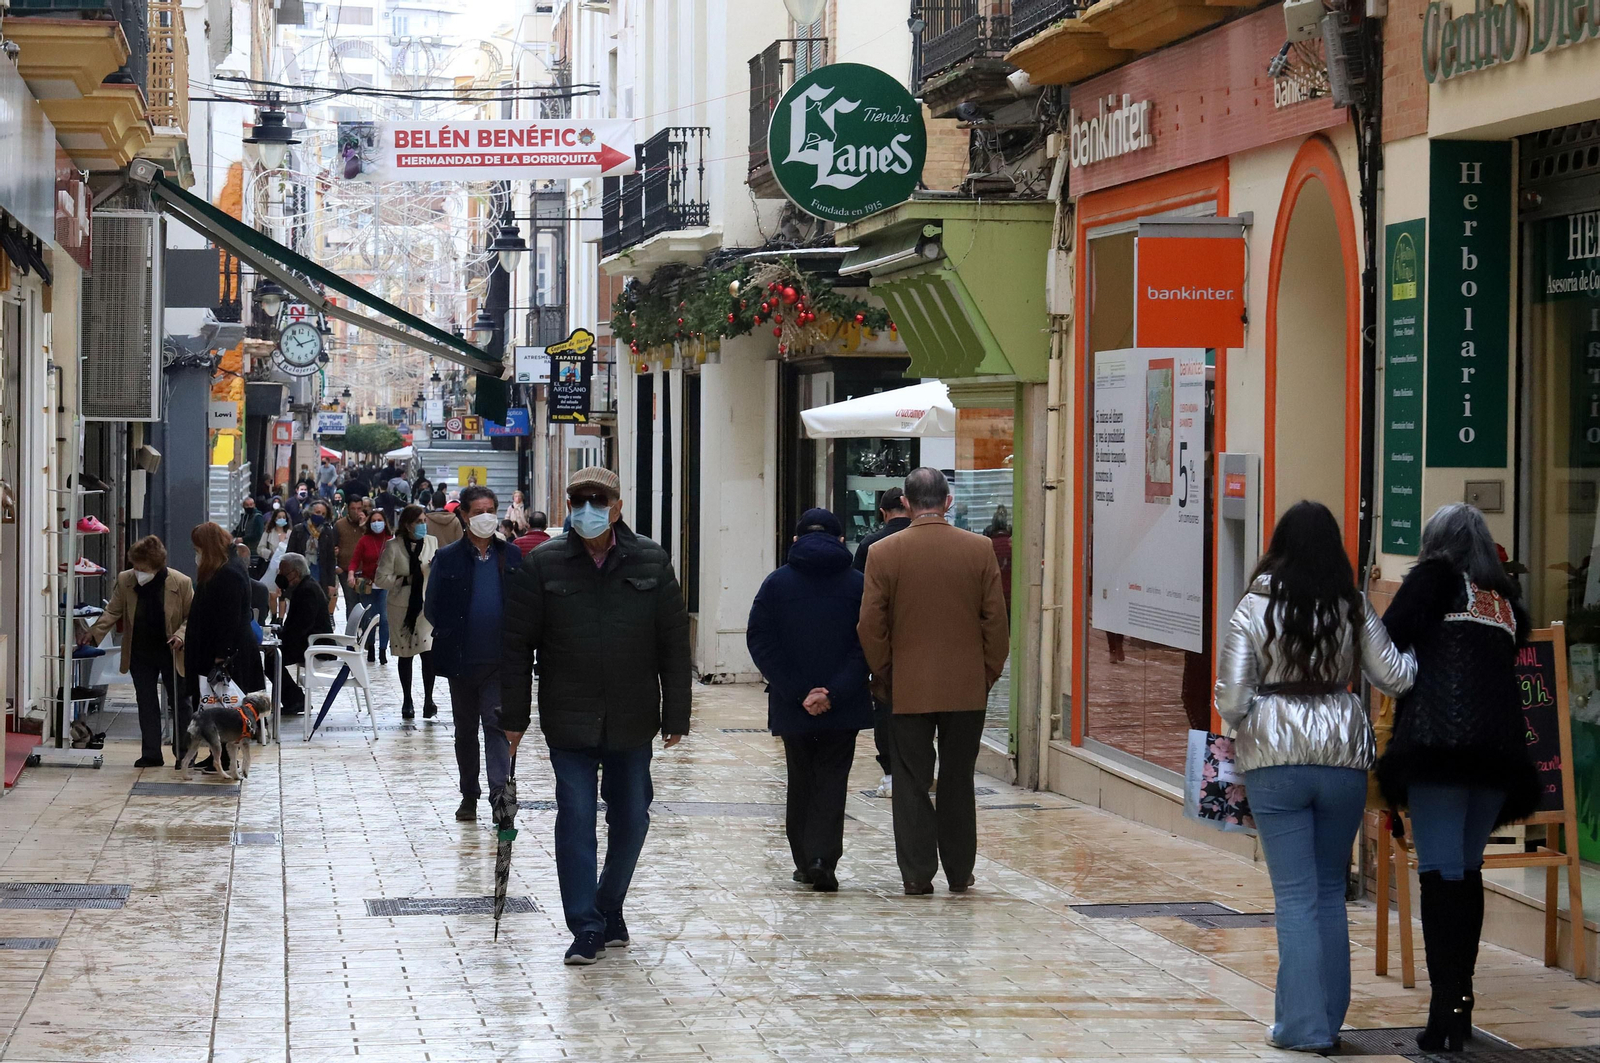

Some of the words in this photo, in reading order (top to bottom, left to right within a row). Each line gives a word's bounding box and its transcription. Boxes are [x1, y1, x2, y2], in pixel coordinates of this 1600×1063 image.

[1422, 0, 1524, 84] Centro
[863, 105, 912, 124] Tiendas
[394, 125, 470, 149] BELÉN
[401, 155, 483, 166] HERMANDAD
[485, 155, 501, 165] DE
[503, 154, 519, 165] LA
[522, 153, 597, 165] BORRIQUITA
[810, 198, 850, 216] Fundada
[851, 208, 863, 216] en
[864, 200, 883, 214] 1915
[1546, 271, 1578, 294] Asesoría
[1579, 270, 1589, 291] de
[1458, 162, 1483, 443] Herbolario
